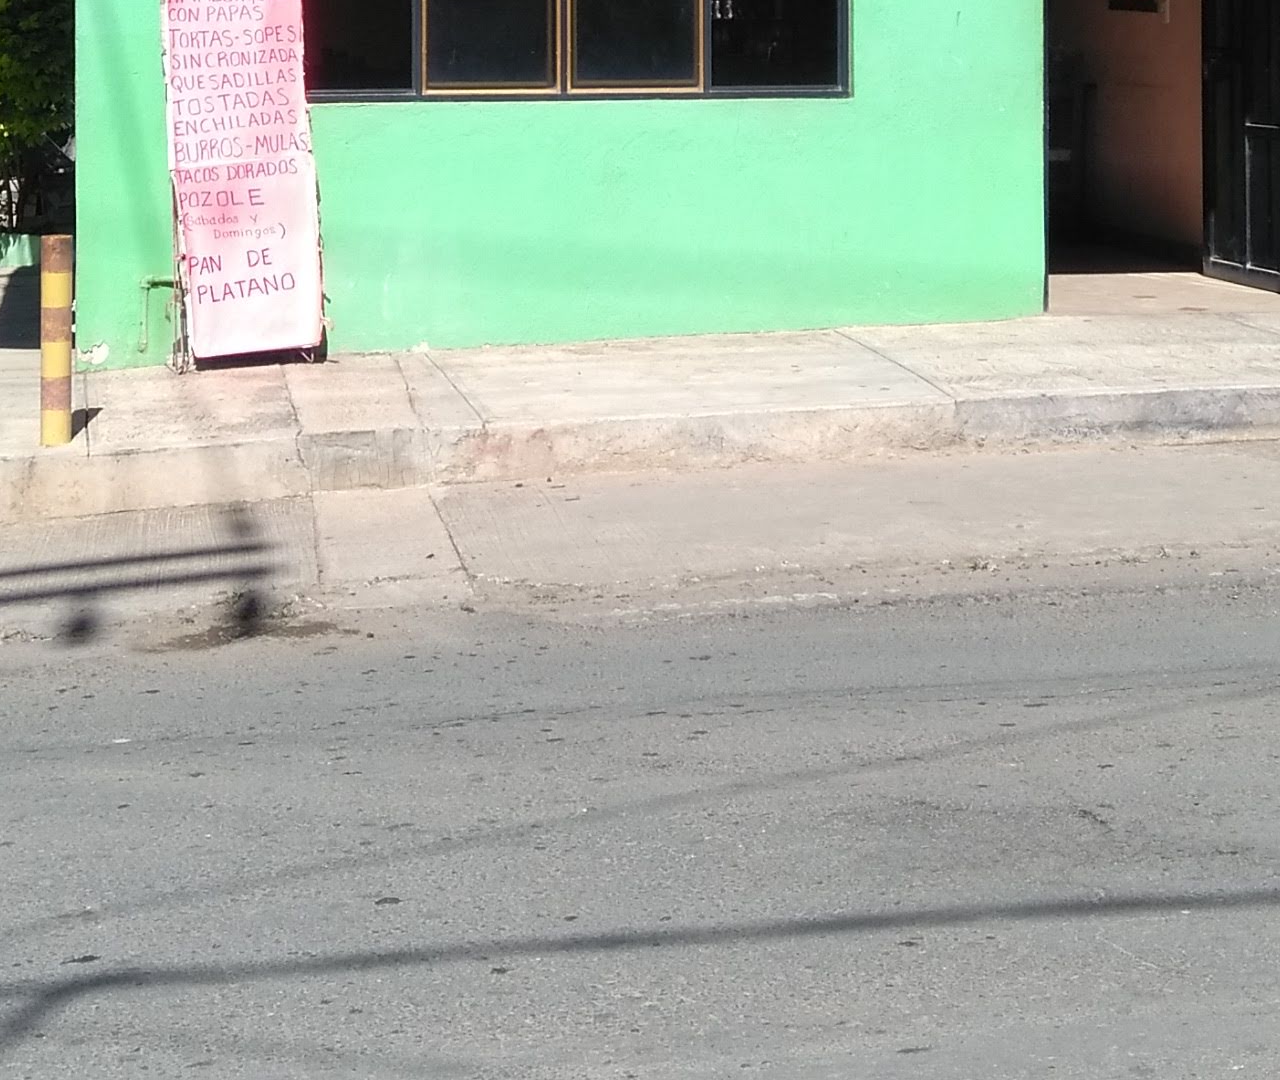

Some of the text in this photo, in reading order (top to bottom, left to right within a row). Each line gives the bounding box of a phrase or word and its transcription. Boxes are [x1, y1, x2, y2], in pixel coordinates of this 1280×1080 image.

[169, 4, 265, 22] CON PAPAS
[171, 68, 297, 93] QUESADILLAS
[172, 88, 290, 116] TOSTADAS
[173, 109, 298, 137] ENCHILADAS
[177, 158, 298, 184] TACOS DORADOS
[178, 188, 265, 210] POZOLE
[189, 248, 273, 276] PAN DE
[197, 272, 296, 305] PLATANO
